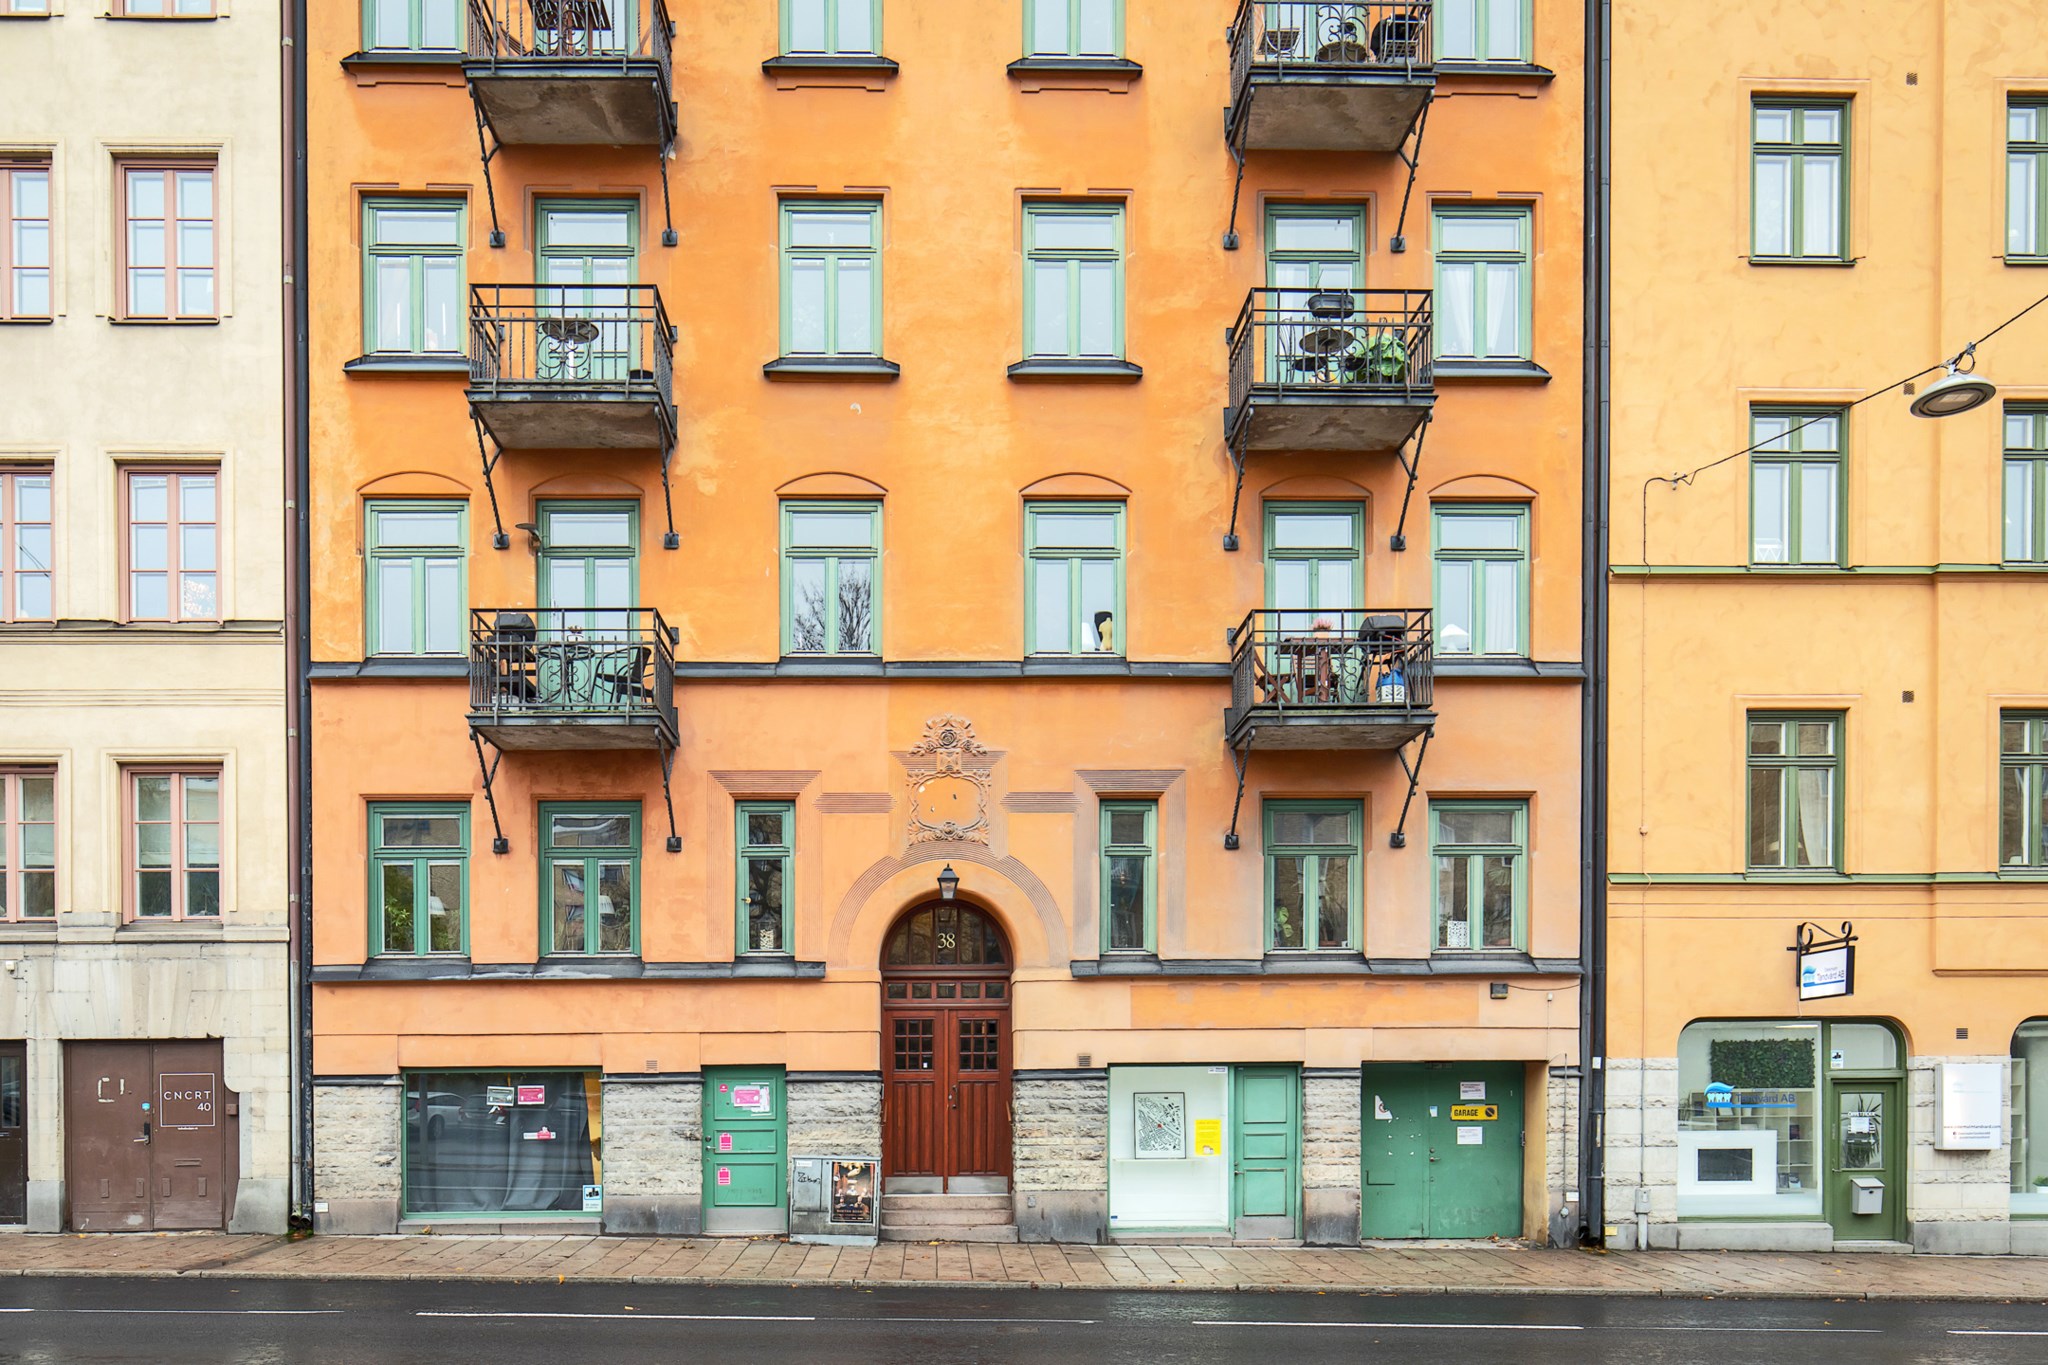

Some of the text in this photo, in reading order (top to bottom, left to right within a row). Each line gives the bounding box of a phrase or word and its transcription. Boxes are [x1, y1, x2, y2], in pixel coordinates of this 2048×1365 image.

[937, 933, 956, 949] 38
[163, 1090, 211, 1100] CNCRT
[1781, 1093, 1796, 1103] AB
[197, 1102, 211, 1111] 40
[1454, 1109, 1479, 1117] GARAGE
